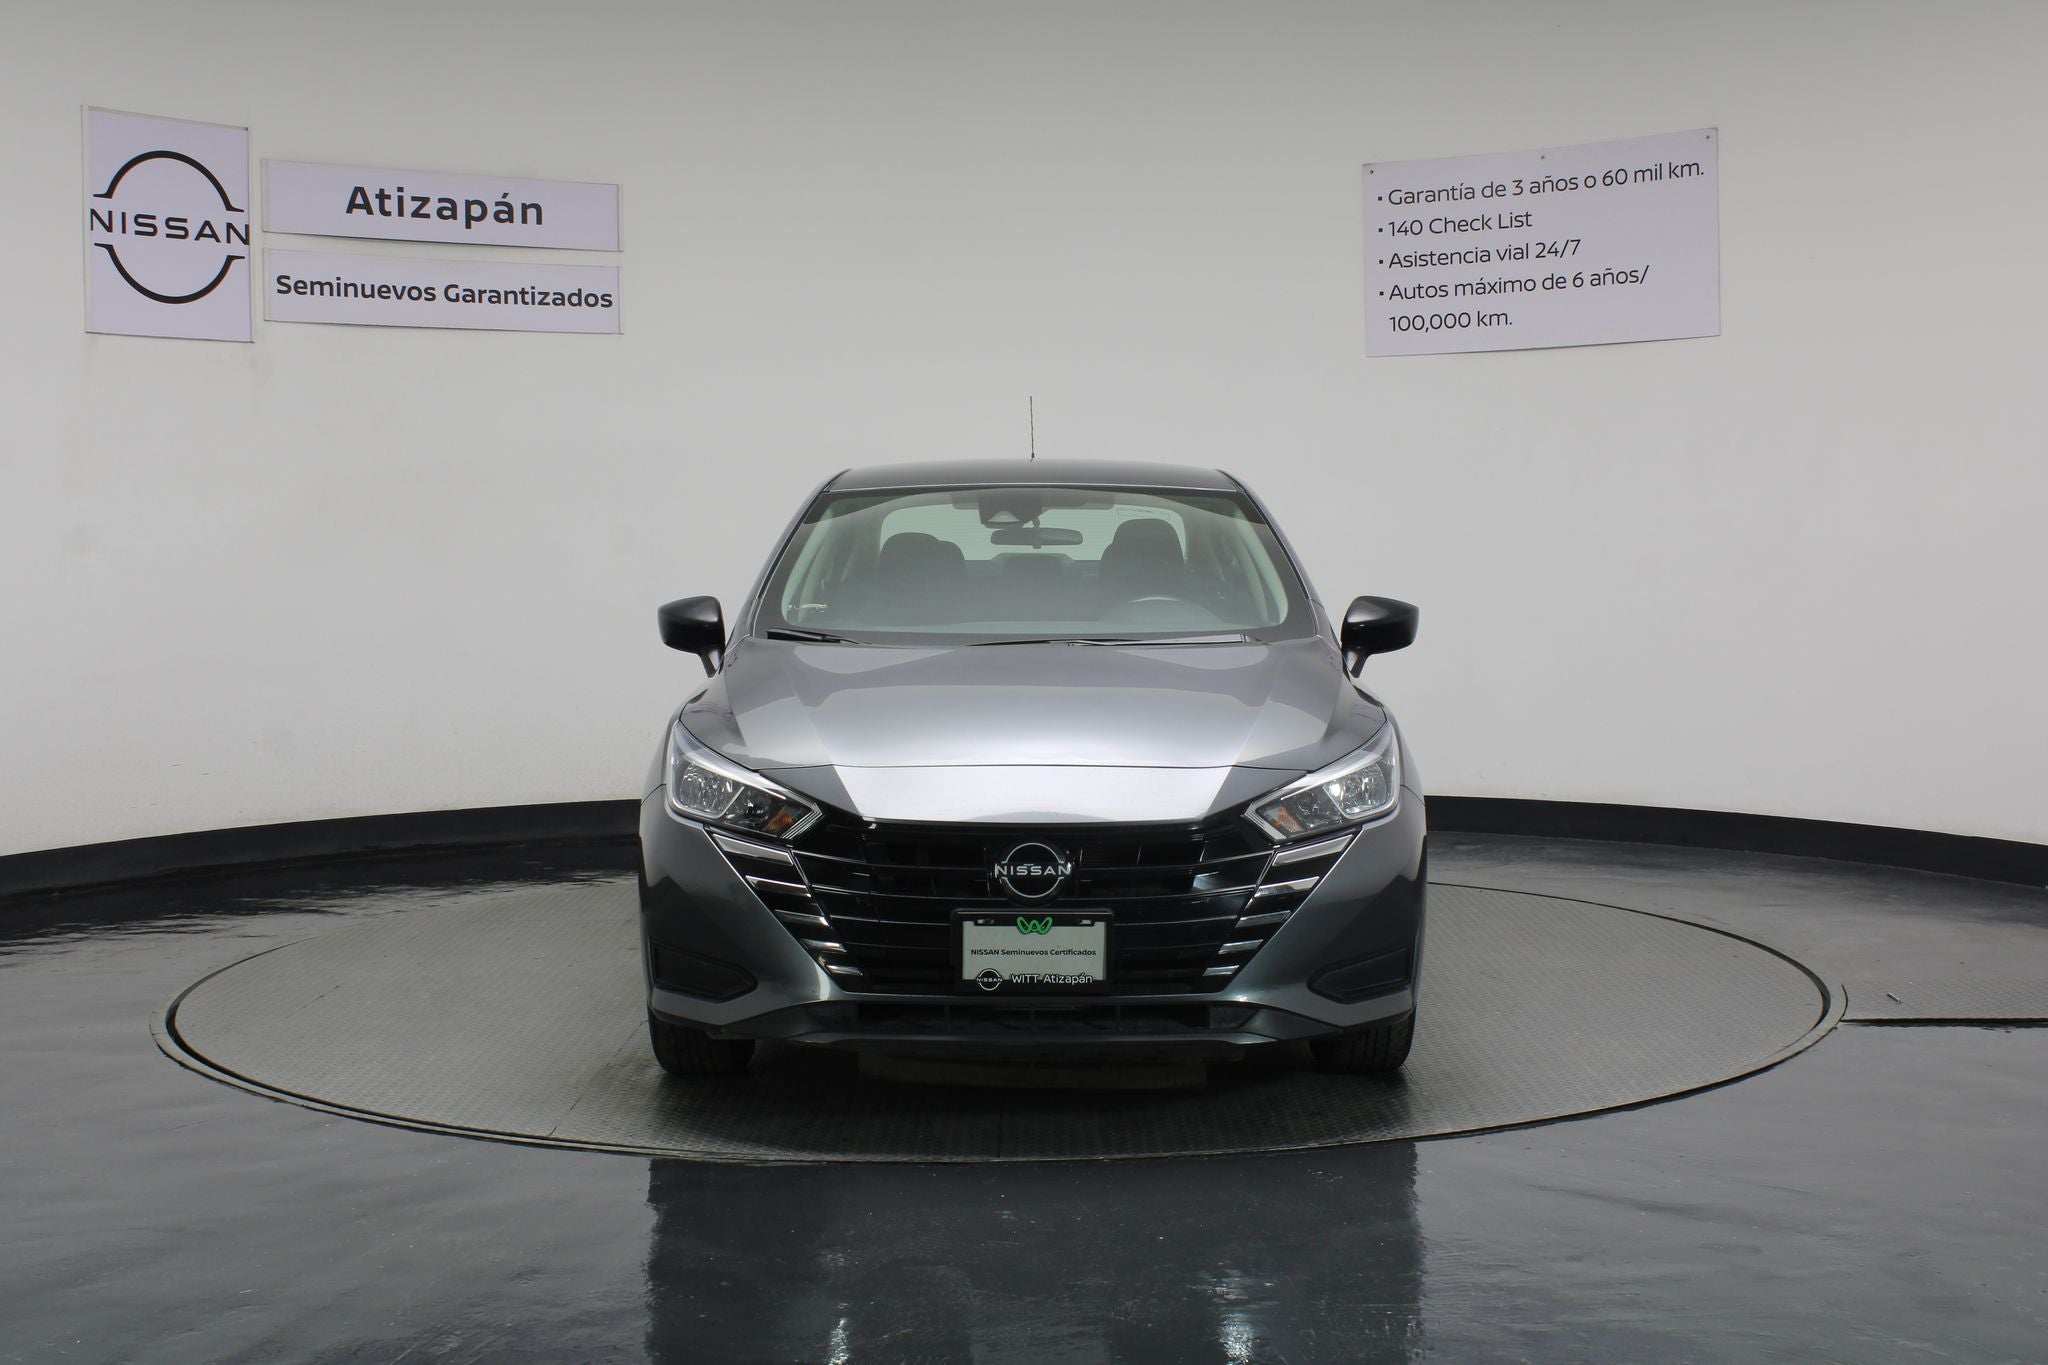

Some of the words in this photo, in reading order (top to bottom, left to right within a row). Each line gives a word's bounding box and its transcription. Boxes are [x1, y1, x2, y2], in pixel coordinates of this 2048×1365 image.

[1388, 182, 1476, 206] Garantía
[1481, 181, 1507, 199] de
[1512, 179, 1524, 196] 3
[1529, 175, 1579, 195] años
[1583, 175, 1597, 189] o
[1602, 168, 1628, 187] 60
[1633, 162, 1663, 184] mil
[1668, 161, 1705, 180] km.
[345, 185, 544, 230] Atizapán
[1388, 219, 1424, 237] 140
[1428, 213, 1493, 235] Check
[1498, 210, 1533, 230] List
[90, 207, 250, 246] NISSAN
[1388, 246, 1491, 269] Asistencia
[1495, 242, 1529, 262] vial
[1535, 238, 1582, 260] 24/7
[275, 273, 437, 303] Seminuevos
[443, 282, 614, 309] Garantizados
[1388, 283, 1449, 301] Autos
[1454, 276, 1537, 297] máximo
[1541, 272, 1567, 291] de
[1572, 271, 1585, 289] 6
[1589, 264, 1650, 287] años/
[1388, 311, 1472, 334] 100,000
[1477, 309, 1513, 328] km.
[994, 863, 1071, 877] NISSAN
[1011, 974, 1040, 984] WITT
[1043, 972, 1093, 986] Atizapán
